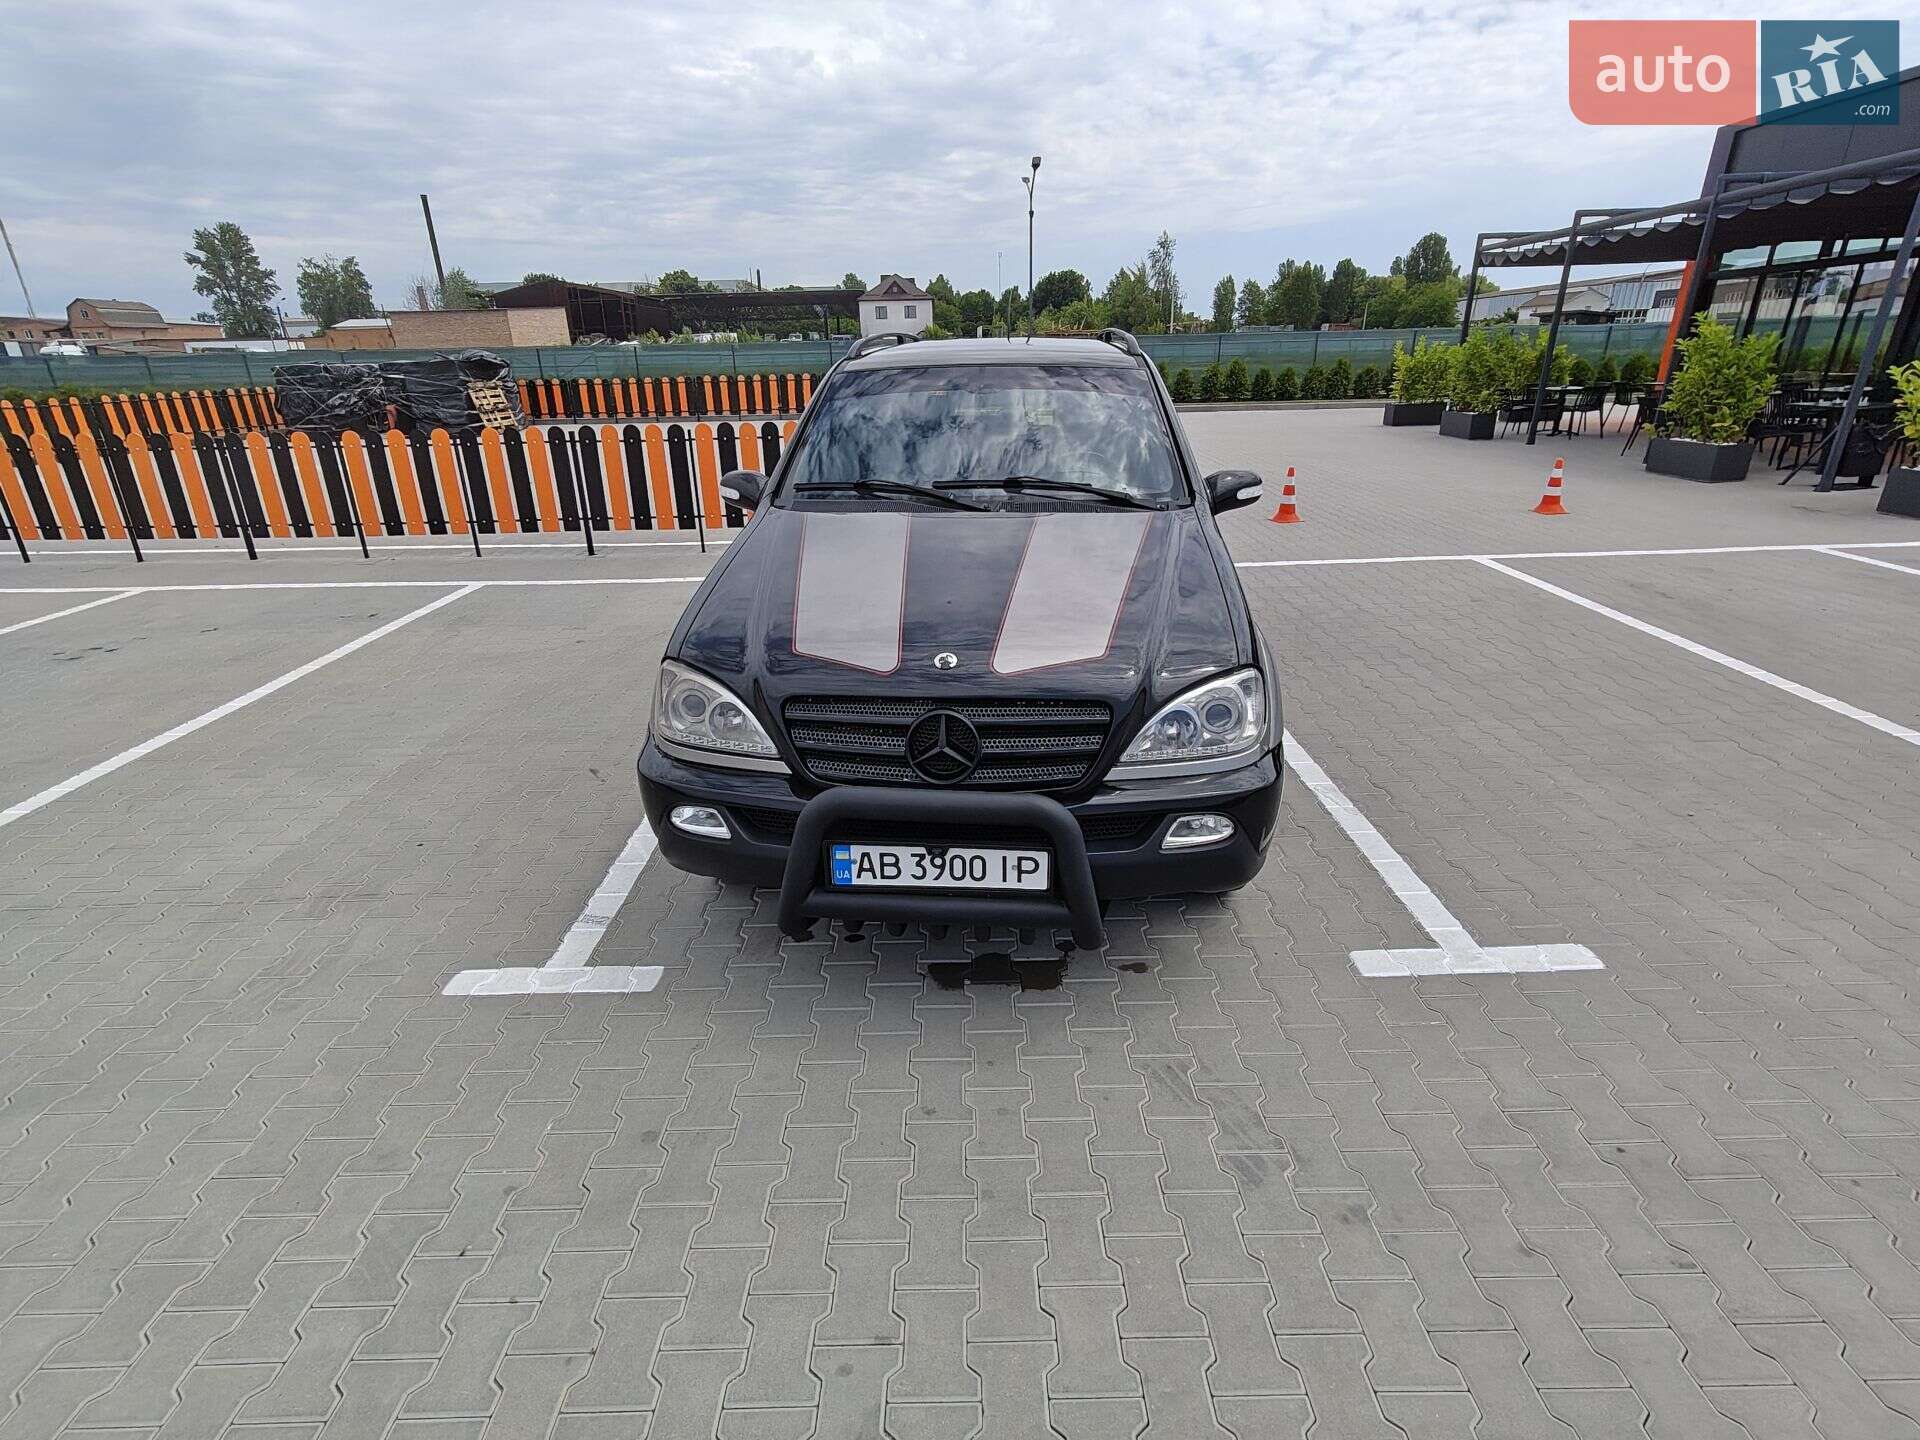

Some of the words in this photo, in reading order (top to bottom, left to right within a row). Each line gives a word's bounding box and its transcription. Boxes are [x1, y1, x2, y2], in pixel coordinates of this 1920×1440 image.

[836, 870, 850, 879] UA
[856, 851, 902, 880] AB
[910, 852, 987, 882] 3900
[1001, 855, 1040, 883] IP
